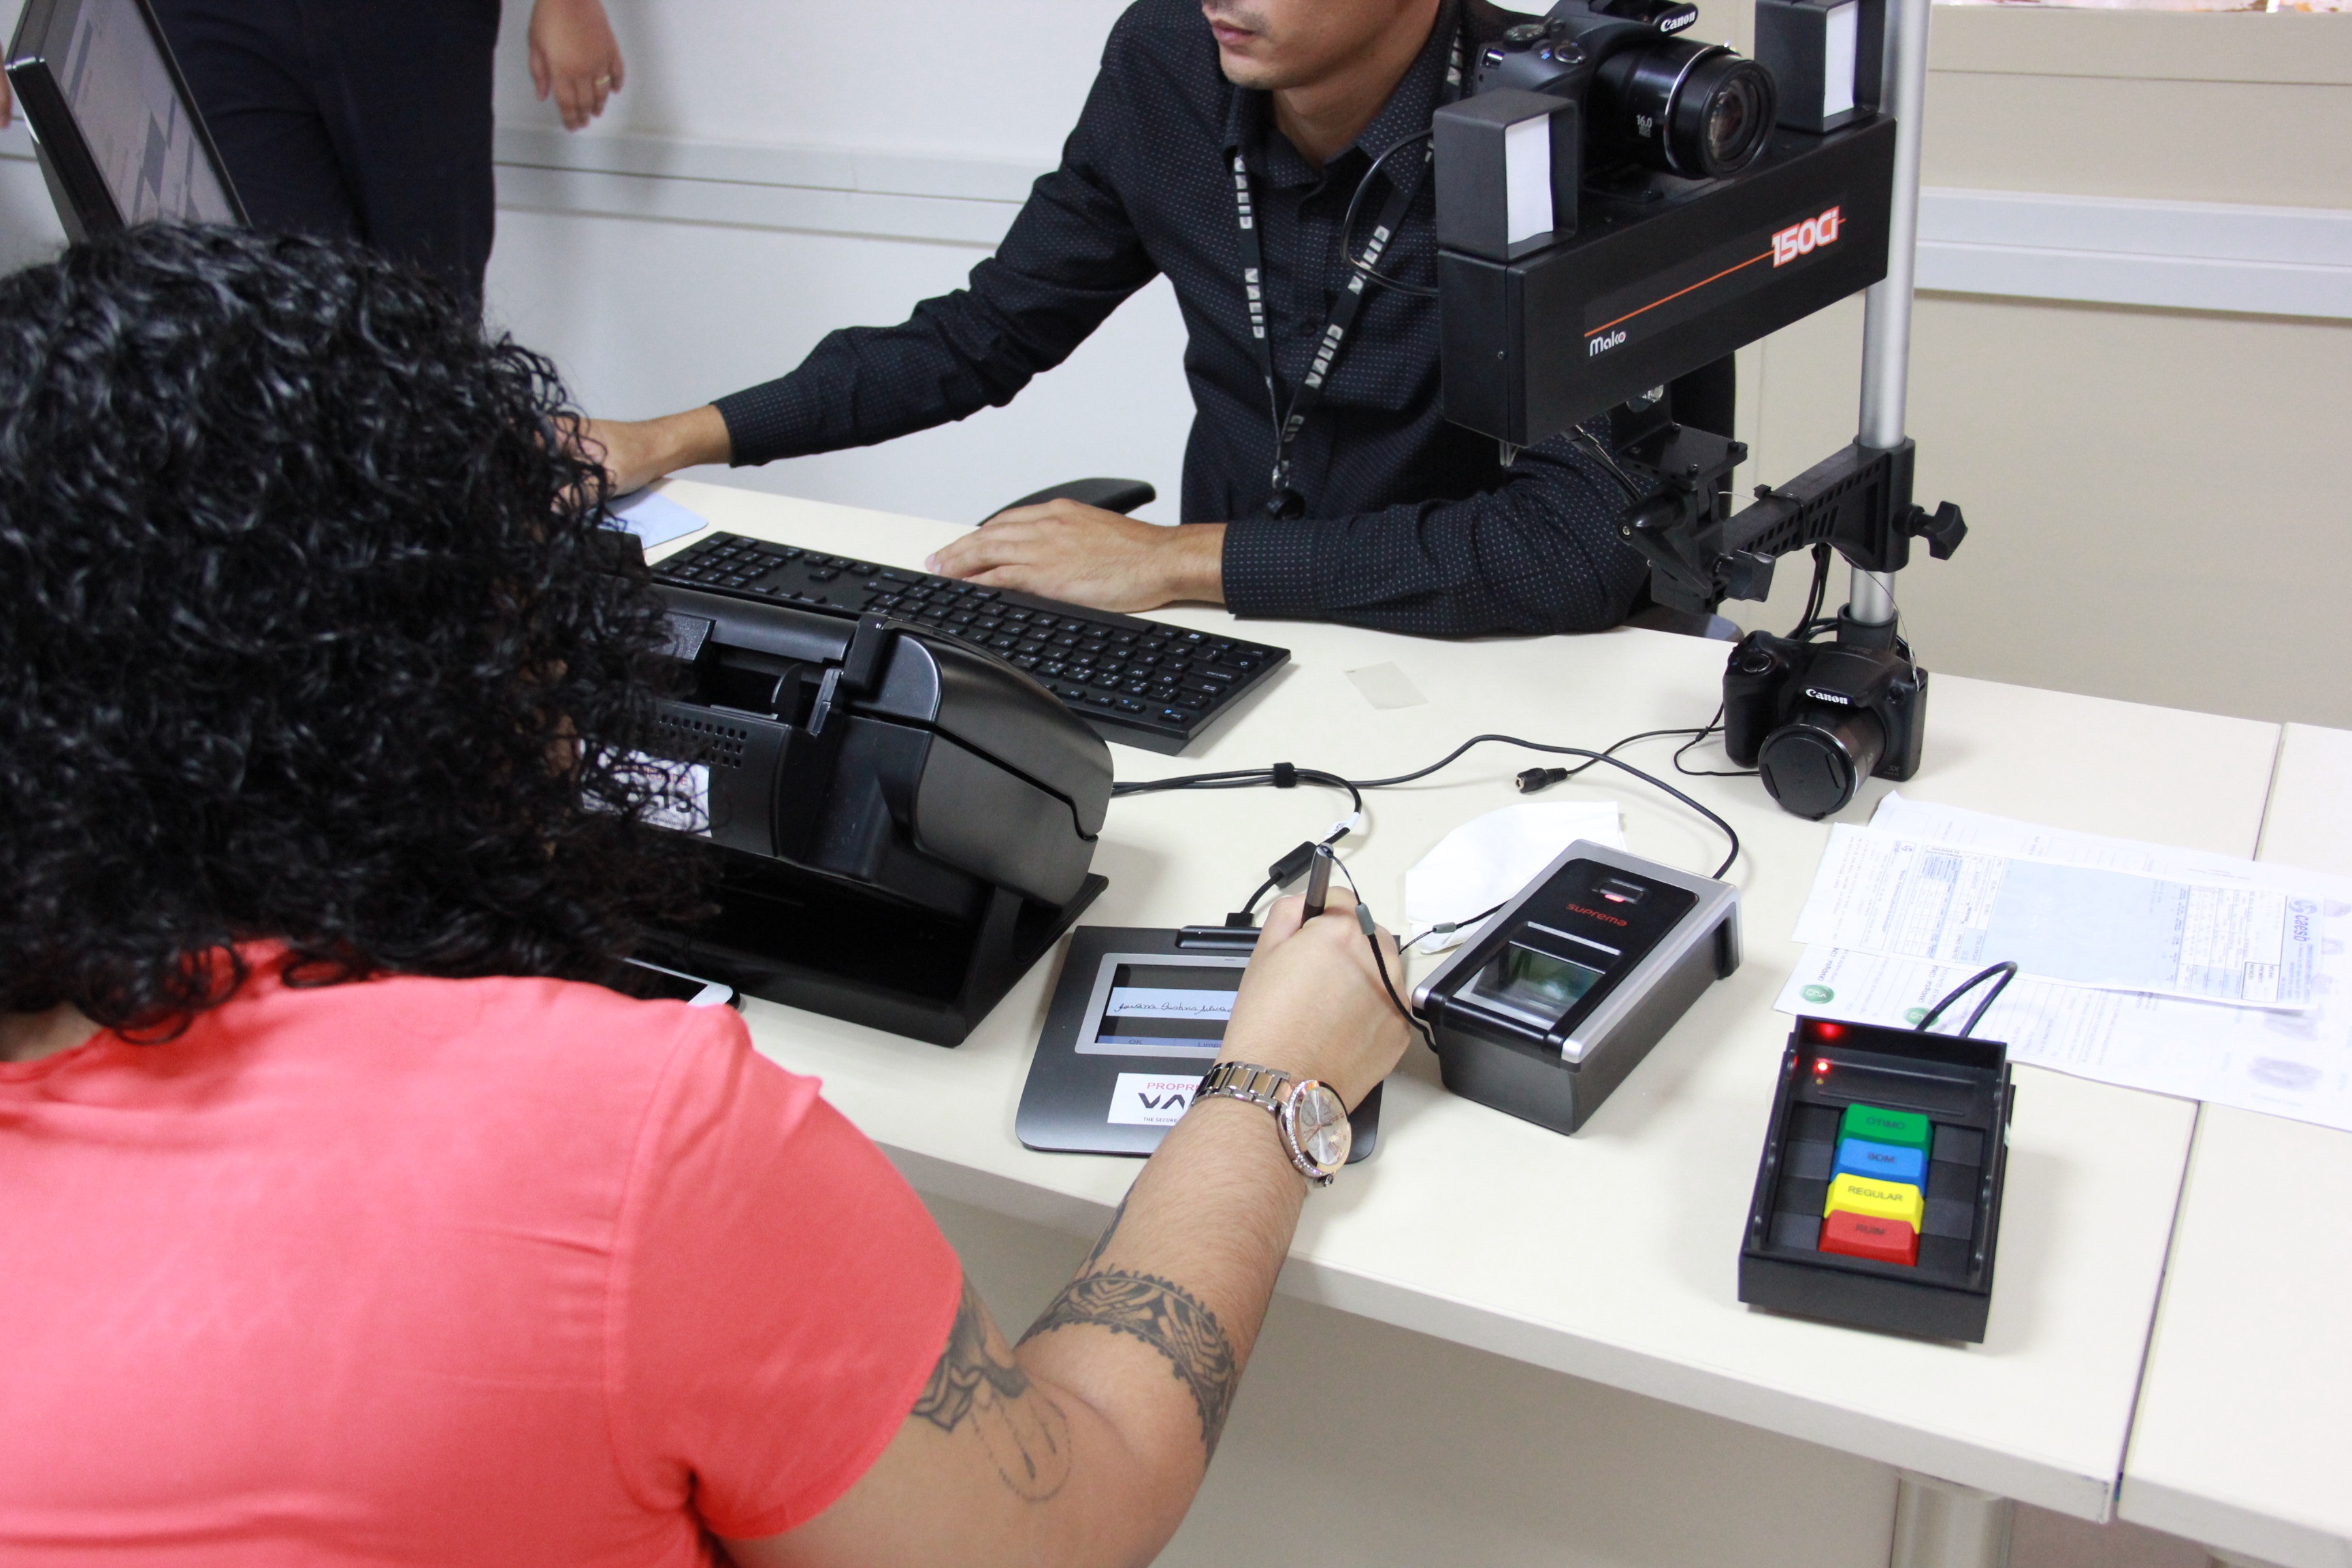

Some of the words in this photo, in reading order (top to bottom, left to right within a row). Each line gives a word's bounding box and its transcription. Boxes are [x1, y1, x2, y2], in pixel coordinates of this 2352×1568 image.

[1660, 11, 1696, 33] Canon
[1771, 206, 1840, 268] 150Ci
[1245, 267, 1265, 339] VALID
[1589, 330, 1627, 357] Mako
[1305, 323, 1344, 389] VALID
[1806, 688, 1848, 705] Canon
[1566, 903, 1628, 927] suprema
[2293, 914, 2310, 943] caesb
[1147, 1082, 1200, 1092] PROPRI
[1138, 1092, 1186, 1110] VA
[1867, 1152, 1895, 1164] BOM
[1848, 1185, 1903, 1202] REGULAR
